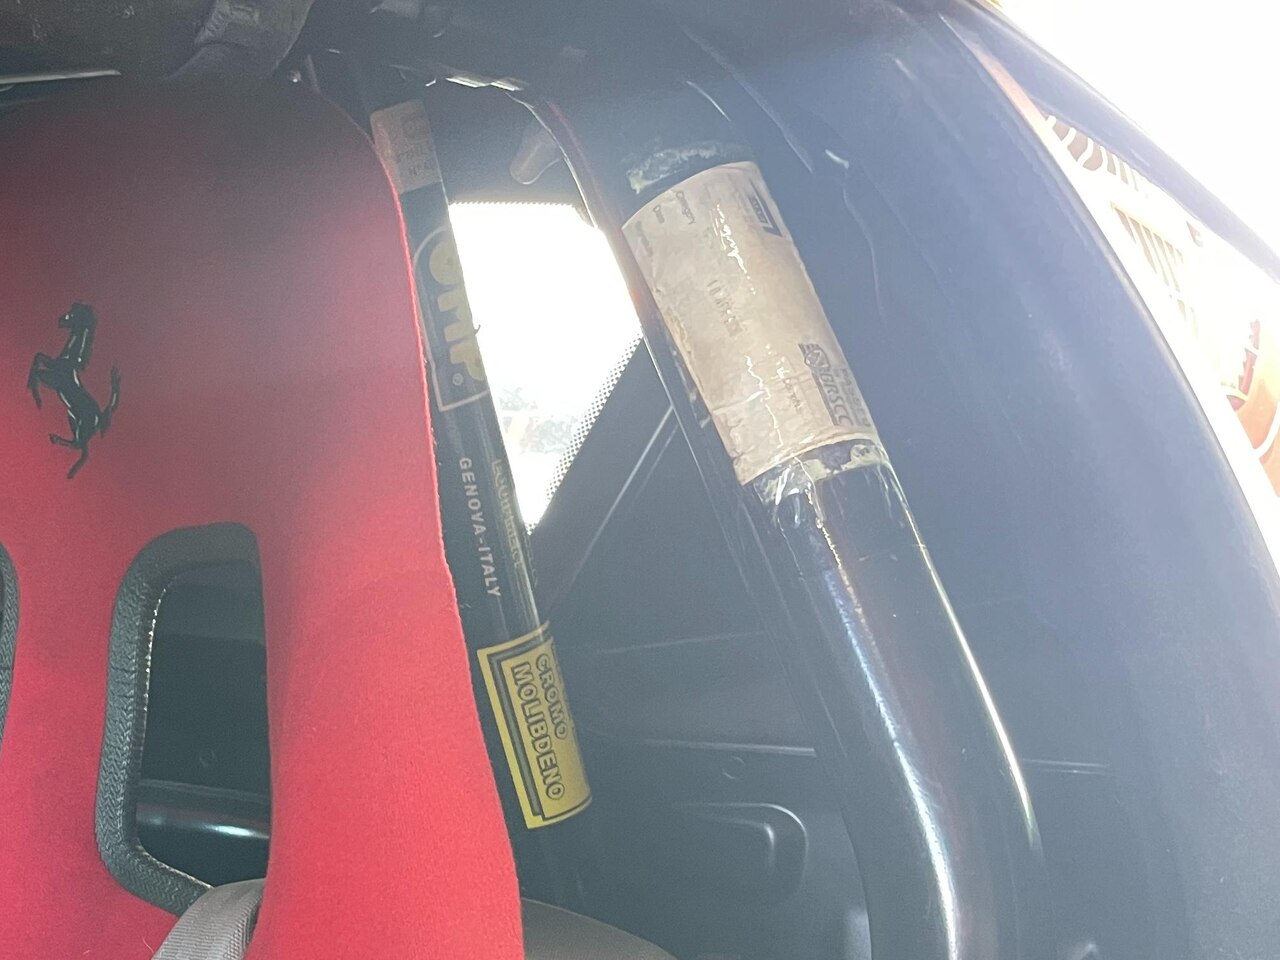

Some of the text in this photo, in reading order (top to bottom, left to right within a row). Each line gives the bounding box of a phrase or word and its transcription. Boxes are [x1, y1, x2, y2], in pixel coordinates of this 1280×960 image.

[459, 457, 501, 597] GENOVA-ITALY
[511, 661, 565, 800] MOLIBDENO
[536, 653, 568, 740] CROMO
